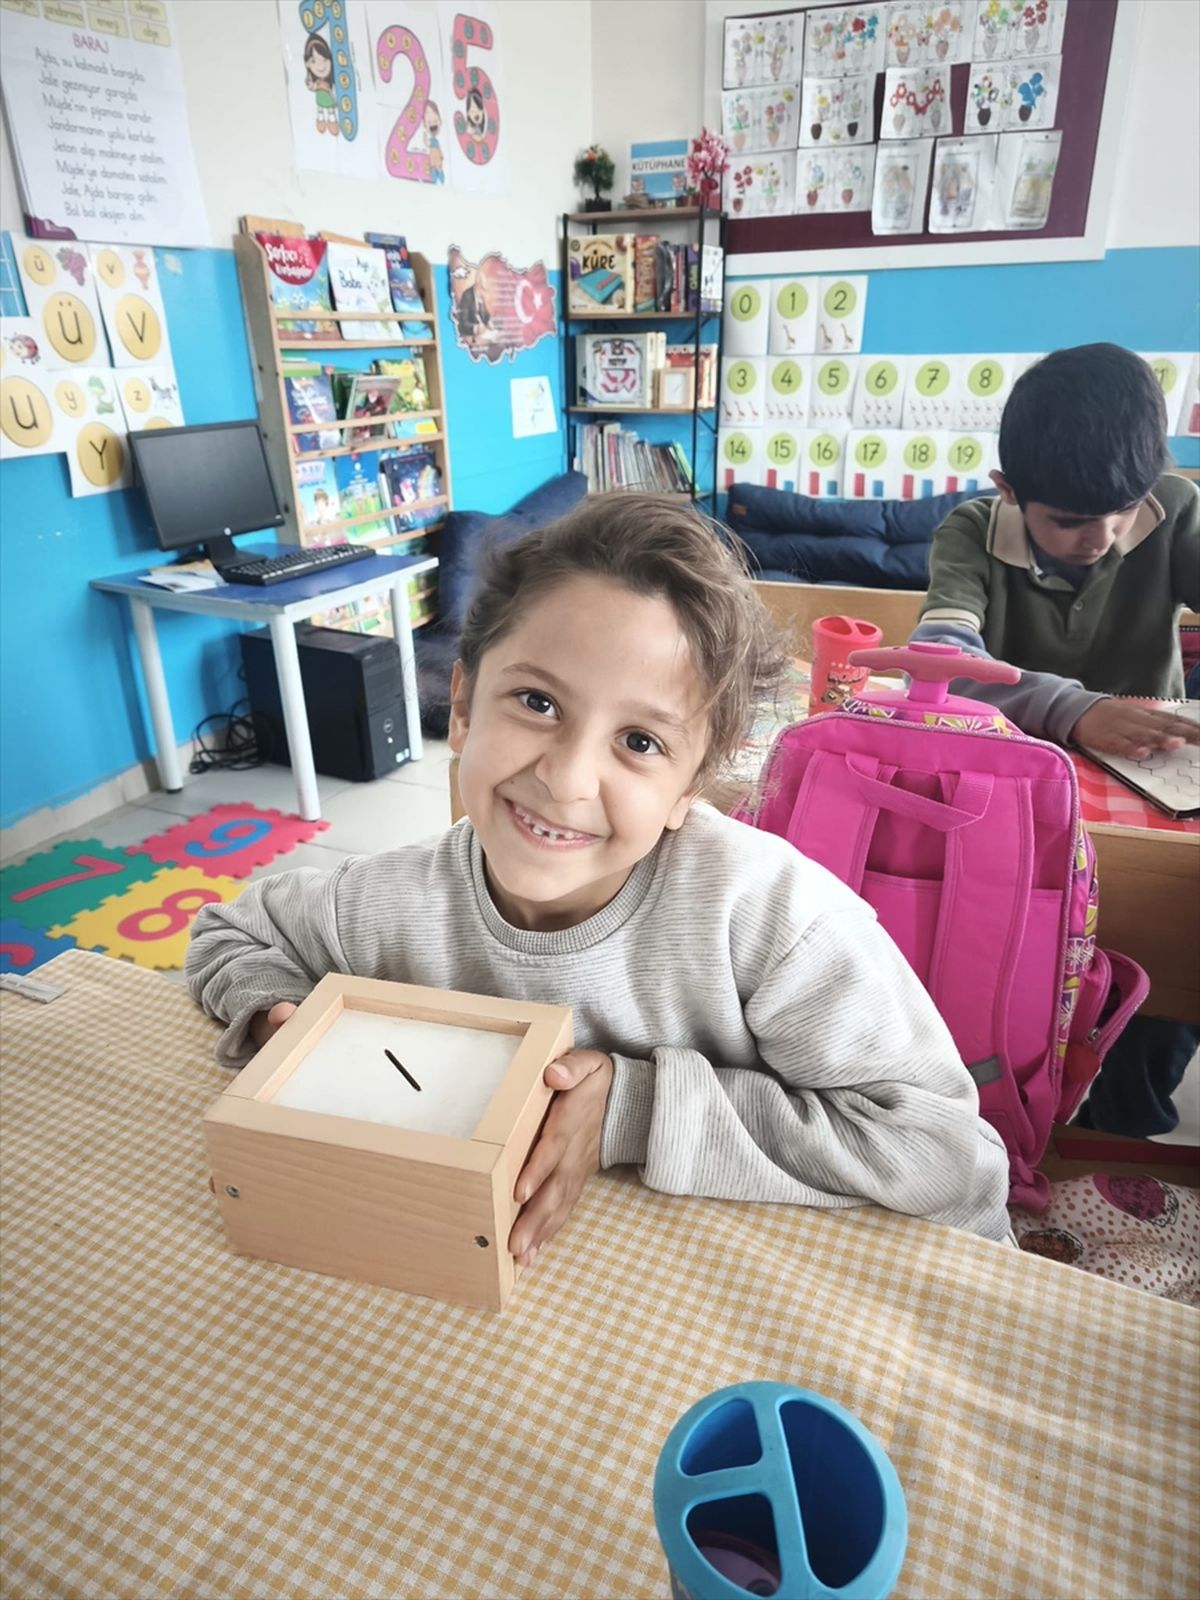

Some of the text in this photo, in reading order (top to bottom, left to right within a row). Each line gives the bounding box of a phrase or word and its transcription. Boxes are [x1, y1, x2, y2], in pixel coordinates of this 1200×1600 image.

[72, 32, 109, 54] BARAJ
[38, 69, 60, 88] Jale
[452, 13, 499, 165] 5
[377, 24, 436, 184] 2
[632, 158, 685, 172] KÜTÜPHANE
[64, 201, 80, 217] Bol
[582, 249, 616, 270] KÜRE
[739, 290, 848, 314] 0 1 2
[736, 368, 748, 388] 3
[780, 368, 793, 387] 4
[827, 367, 840, 388] 5
[874, 369, 887, 389] 6
[927, 368, 940, 389] 7
[979, 367, 993, 389] 8
[730, 439, 975, 465] 14 15 16 17 18 19
[117, 888, 222, 941] 8
